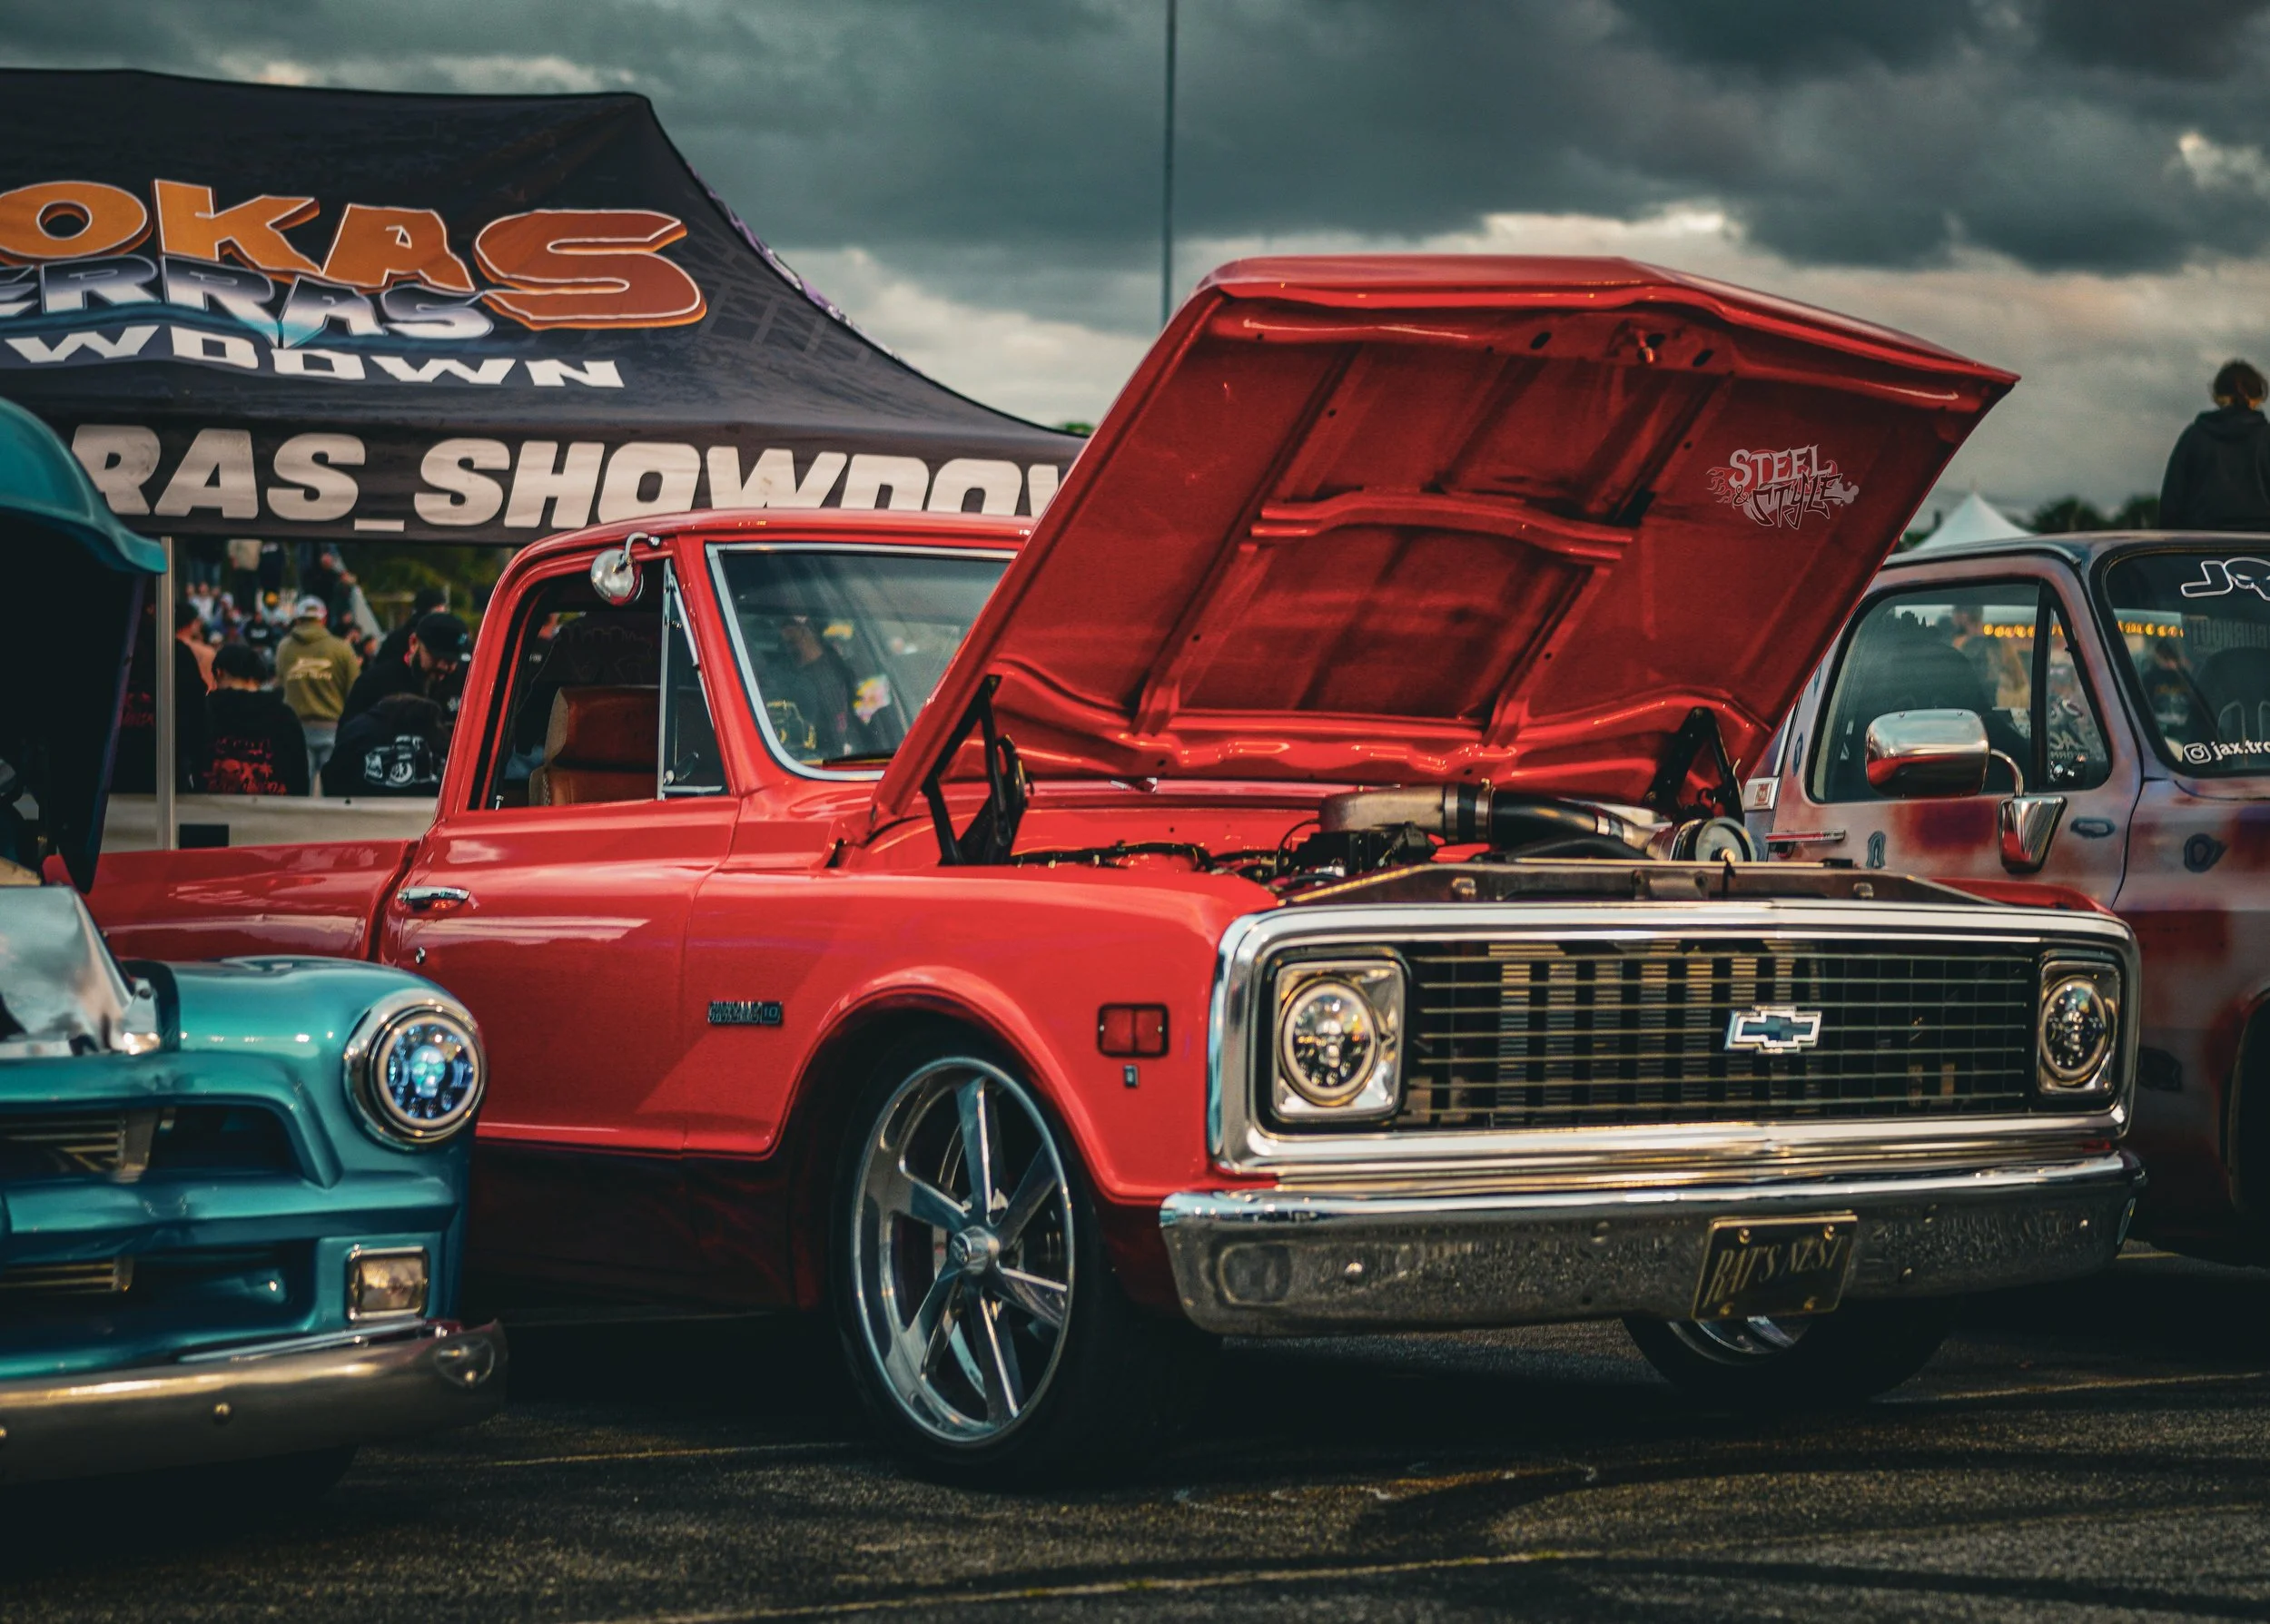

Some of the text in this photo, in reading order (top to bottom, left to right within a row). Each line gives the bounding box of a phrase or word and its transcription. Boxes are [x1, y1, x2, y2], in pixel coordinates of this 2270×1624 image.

[0, 179, 706, 330] OKAS
[71, 425, 1060, 532] RAS_SHOWDO
[1728, 444, 1833, 487] STEEL
[1752, 472, 1843, 530] STYLE
